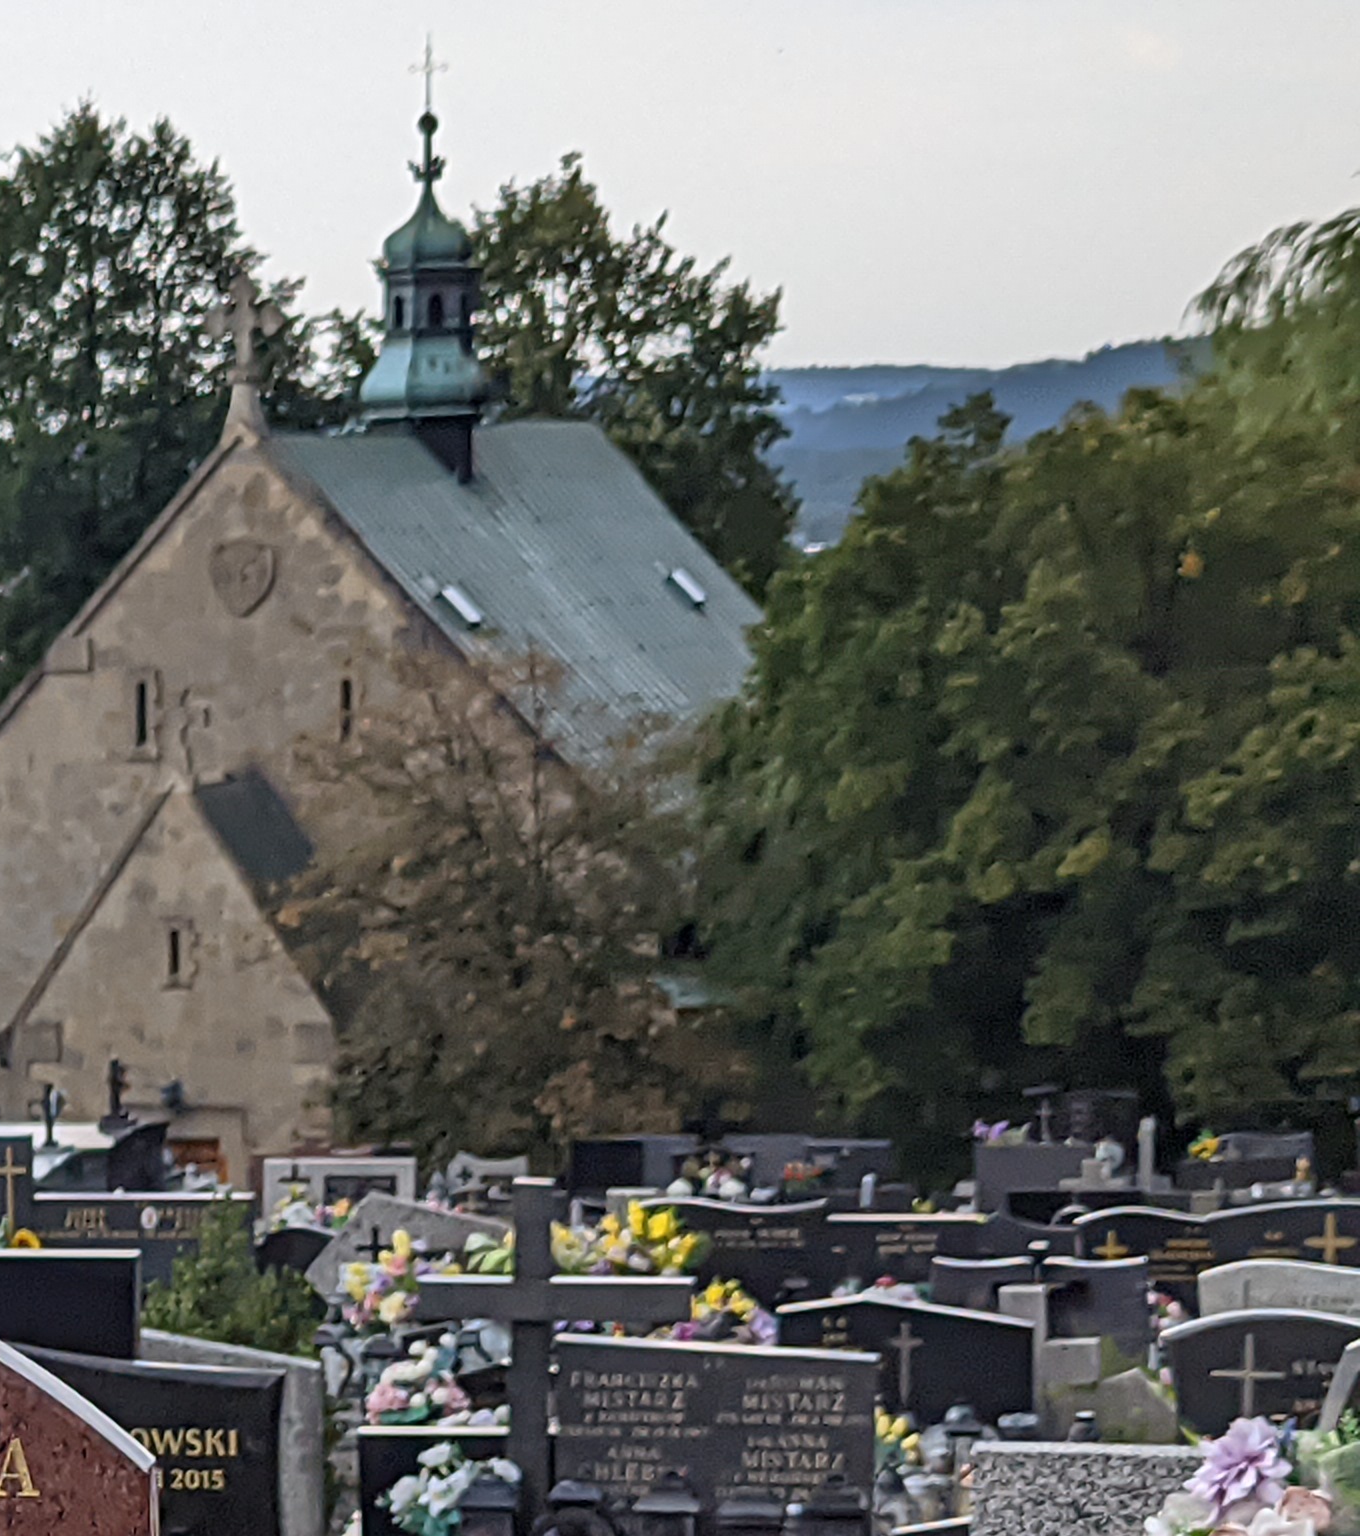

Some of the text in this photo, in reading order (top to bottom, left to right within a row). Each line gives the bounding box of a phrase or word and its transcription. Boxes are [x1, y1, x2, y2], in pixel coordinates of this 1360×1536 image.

[569, 1370, 700, 1389] FRANCIZKA
[741, 1393, 846, 1412] MISTARZ
[169, 1468, 226, 1490] 2015
